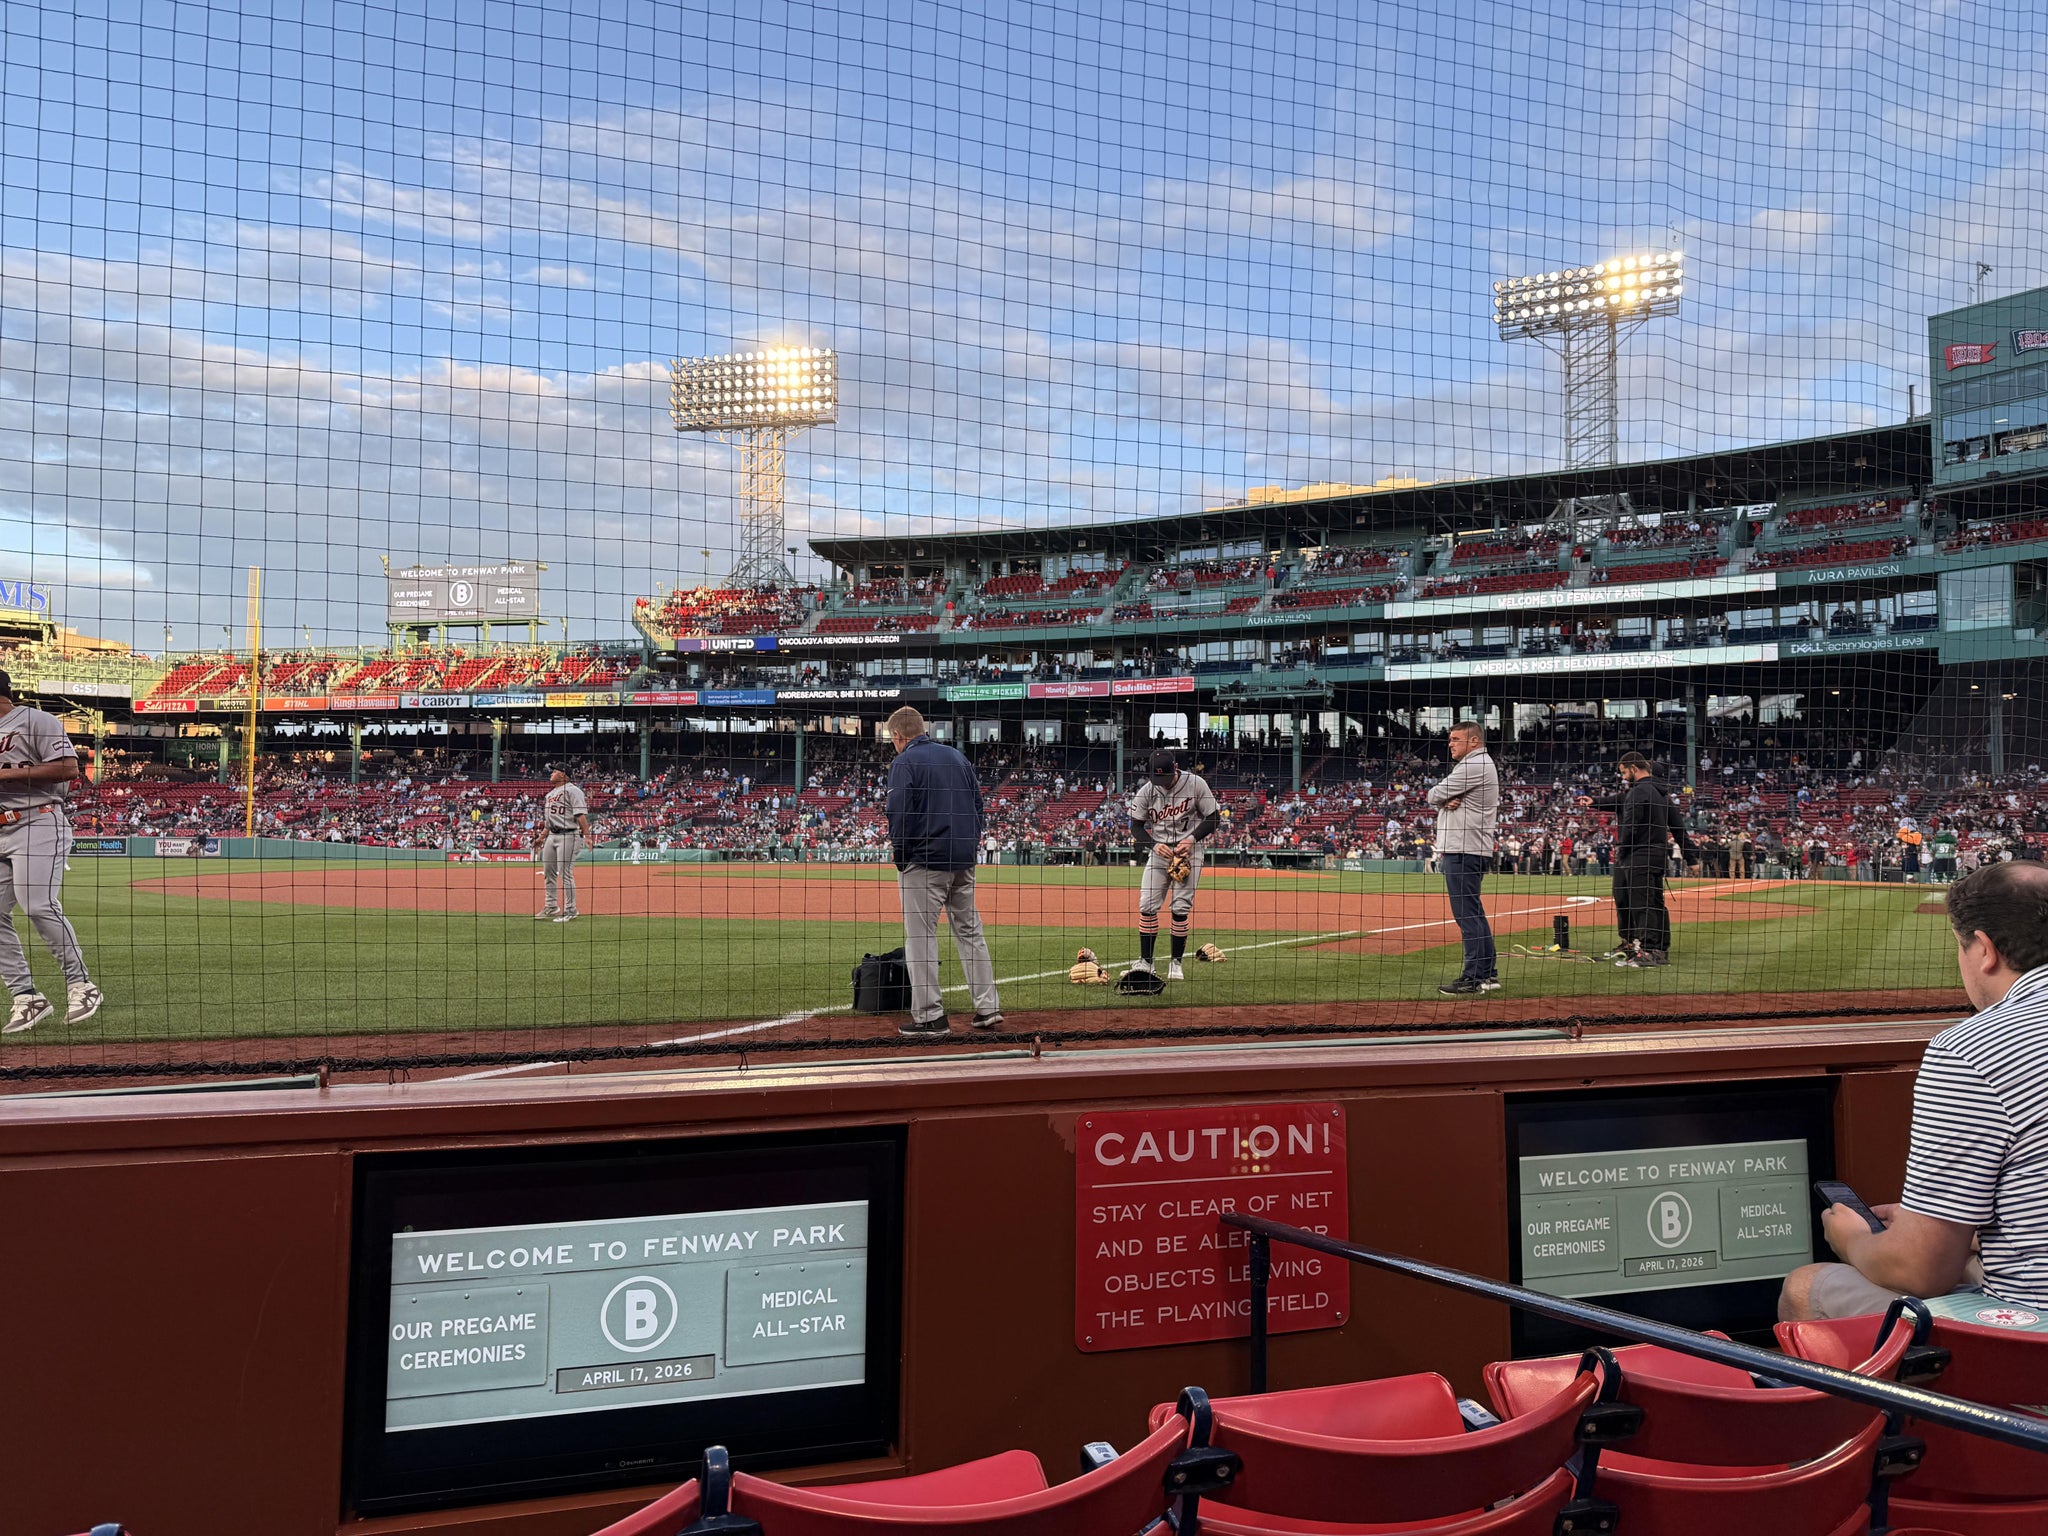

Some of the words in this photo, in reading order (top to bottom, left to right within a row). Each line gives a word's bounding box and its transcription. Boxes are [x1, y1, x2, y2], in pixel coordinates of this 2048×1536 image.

[400, 569, 443, 577] WELCOME
[448, 568, 459, 576] TO
[462, 567, 498, 575] FENWAY
[1848, 565, 1899, 578] PAVILION
[1498, 594, 1548, 607] WELCOME
[1550, 593, 1564, 604] TO
[1567, 591, 1614, 602] FENWAY
[1615, 588, 1645, 599] PARK
[1275, 614, 1312, 623] PAVILION
[712, 639, 754, 649] UNITED
[824, 636, 863, 645] RENOWNED
[865, 635, 900, 643] SURGEON
[1791, 643, 1823, 654] DELL
[1823, 639, 1892, 652] Technologies
[1895, 637, 1924, 647] Level
[1474, 660, 1529, 673] AMERICA'S
[1532, 660, 1560, 670] MOST
[1563, 657, 1612, 669] BELOVED
[72, 684, 99, 694] 6:57
[863, 690, 877, 698] THE
[879, 689, 900, 697] CHIEF
[992, 687, 1022, 695] PICKLES
[1045, 686, 1065, 694] Ninety
[1077, 685, 1093, 693] Nine
[1115, 684, 1152, 692] Safelite
[163, 702, 187, 711] PIZZA
[284, 700, 309, 708] STIHL
[334, 698, 356, 708] King's
[550, 806, 565, 815] 50
[1148, 797, 1193, 823] Detroit
[1181, 817, 1189, 831] 7
[1094, 1123, 1331, 1166] CAUTION!
[1539, 1167, 1629, 1188] WELCOME
[1637, 1165, 1660, 1180] TO
[1668, 1159, 1737, 1179] FENWAY
[1744, 1156, 1788, 1172] PARK
[1092, 1203, 1147, 1224] STAY
[1159, 1198, 1236, 1219] CLEAR
[1248, 1195, 1280, 1212] OF
[1291, 1191, 1333, 1210] NET
[1740, 1203, 1787, 1218] MEDICAL
[1527, 1222, 1551, 1236] OUR
[1555, 1217, 1611, 1233] PREGAME
[1661, 1201, 1682, 1239] B
[1737, 1223, 1792, 1239] ALL-STAR
[418, 1244, 574, 1275] WELCOME
[588, 1241, 628, 1262] TO
[643, 1231, 760, 1258] FENWAY
[773, 1223, 846, 1247] PARK
[1096, 1239, 1143, 1259] AND
[1156, 1235, 1187, 1254] BE
[1533, 1240, 1606, 1257] CEREMONIES
[1639, 1259, 1664, 1271] APRIL
[1666, 1259, 1679, 1271] 17,
[1681, 1256, 1704, 1269] 2026
[1105, 1268, 1216, 1294] OBJECTS
[1228, 1259, 1322, 1283] LEVING
[761, 1288, 838, 1309] MEDICAL
[625, 1289, 659, 1340] B
[1096, 1309, 1145, 1329] THE
[1157, 1299, 1252, 1324] PLAYING
[1267, 1292, 1329, 1313] FIELD
[392, 1321, 432, 1341] OUR
[441, 1313, 537, 1337] PREGAME
[753, 1315, 846, 1339] ALL-STAR
[400, 1343, 526, 1371] CEREMONIES
[582, 1367, 625, 1386] APRIL
[630, 1366, 649, 1385] 17,
[655, 1363, 693, 1379] 2026
